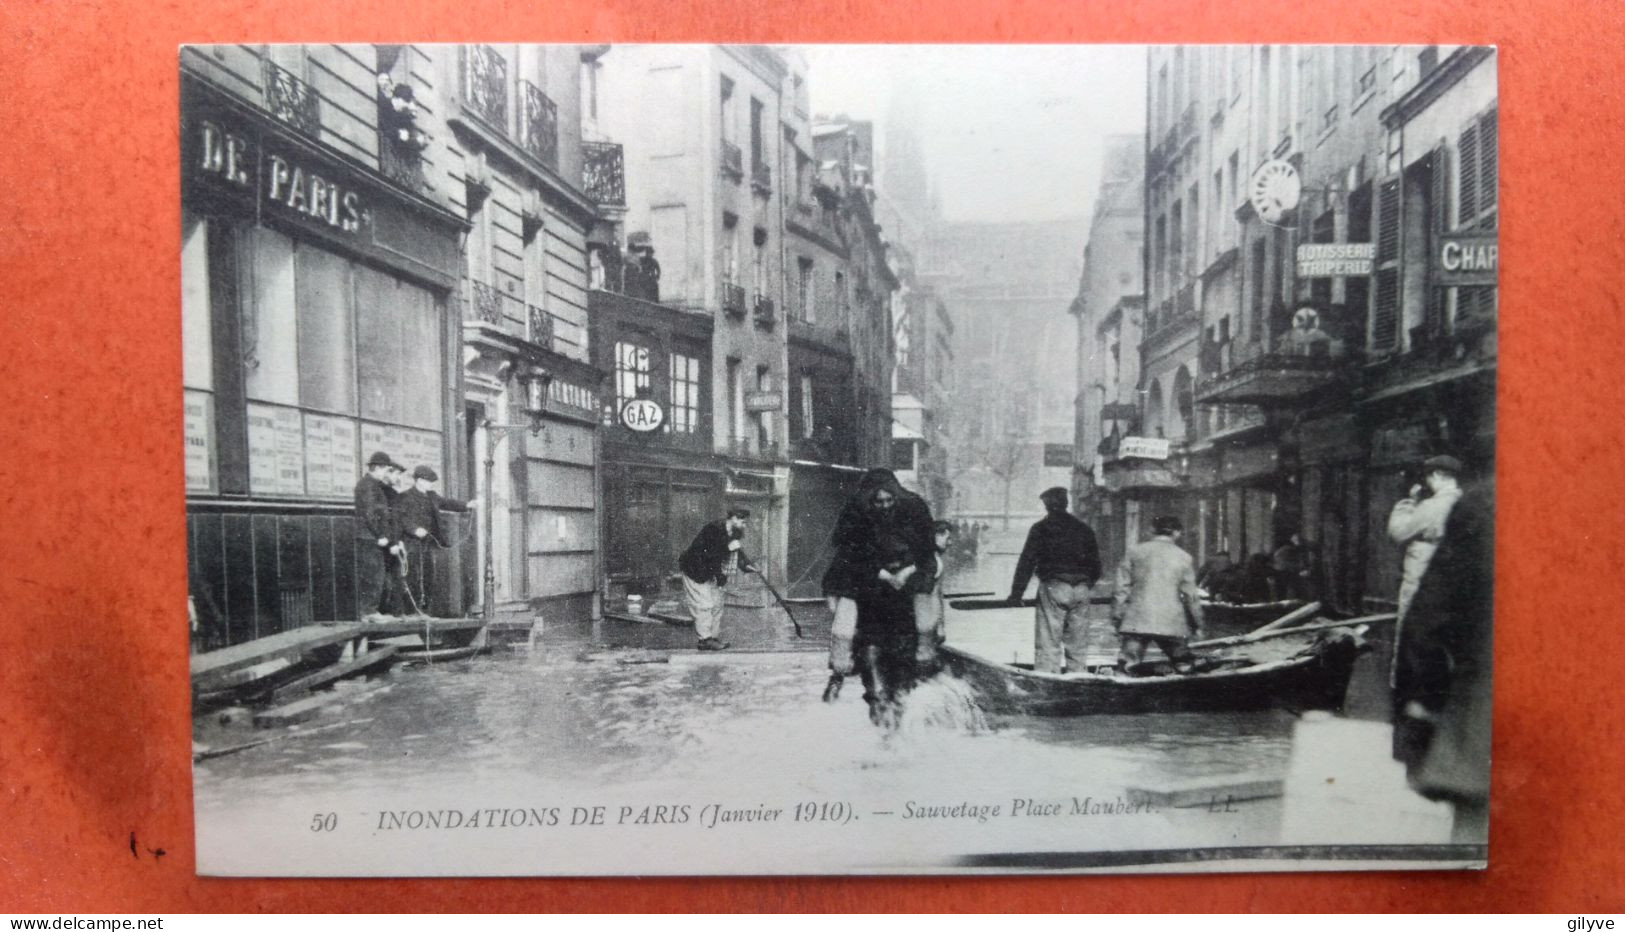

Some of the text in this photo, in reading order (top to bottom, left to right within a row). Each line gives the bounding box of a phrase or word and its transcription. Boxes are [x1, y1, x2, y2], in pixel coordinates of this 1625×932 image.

[202, 120, 359, 232] DE PARIS
[1300, 260, 1371, 276] TRIPERIE
[627, 403, 657, 426] GAZ
